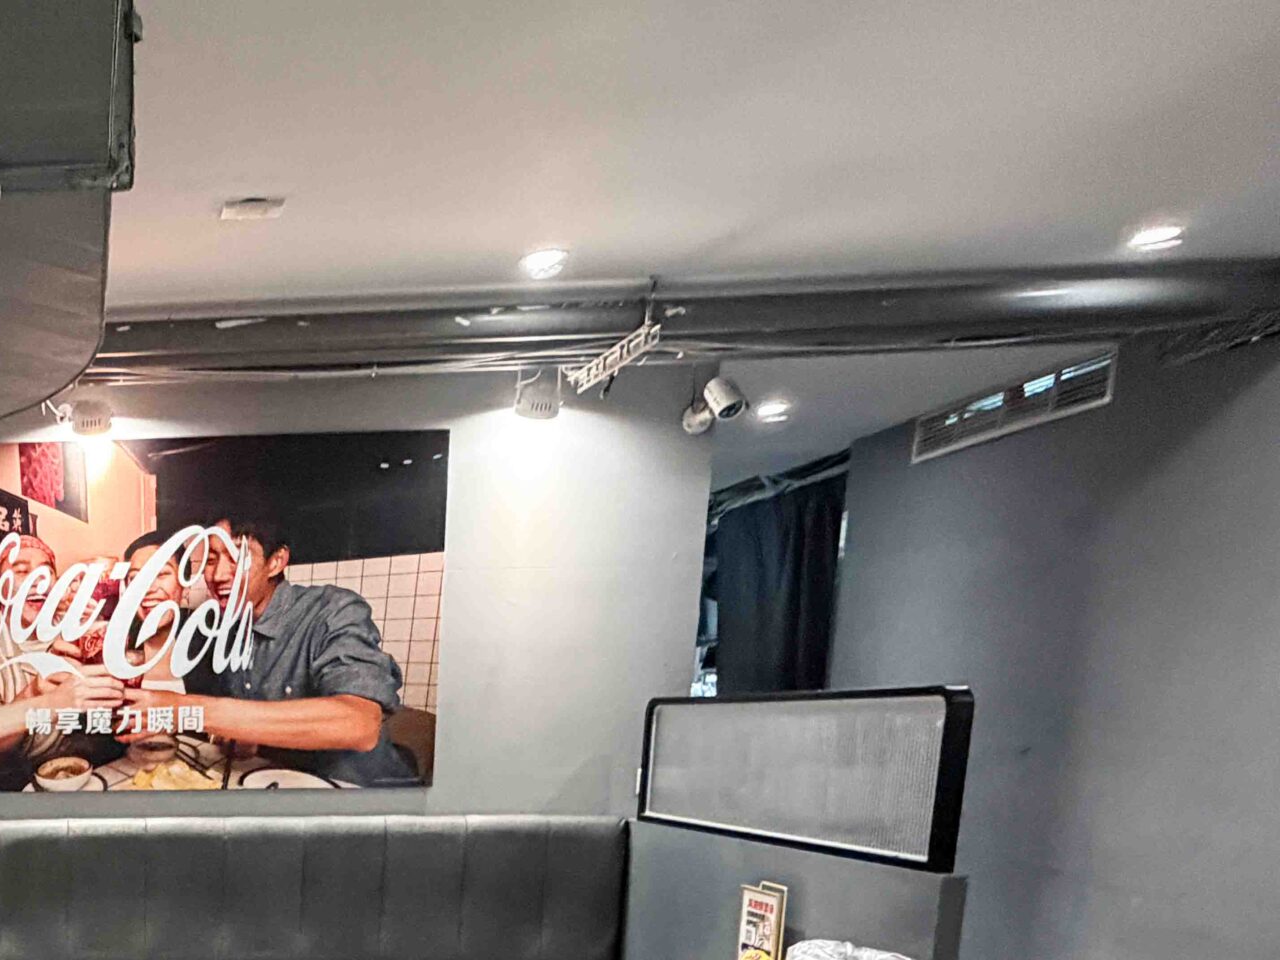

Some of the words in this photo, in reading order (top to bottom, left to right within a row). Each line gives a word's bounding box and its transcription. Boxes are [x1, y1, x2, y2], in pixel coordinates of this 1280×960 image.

[25, 706, 205, 735] 暢享魔力瞬間
